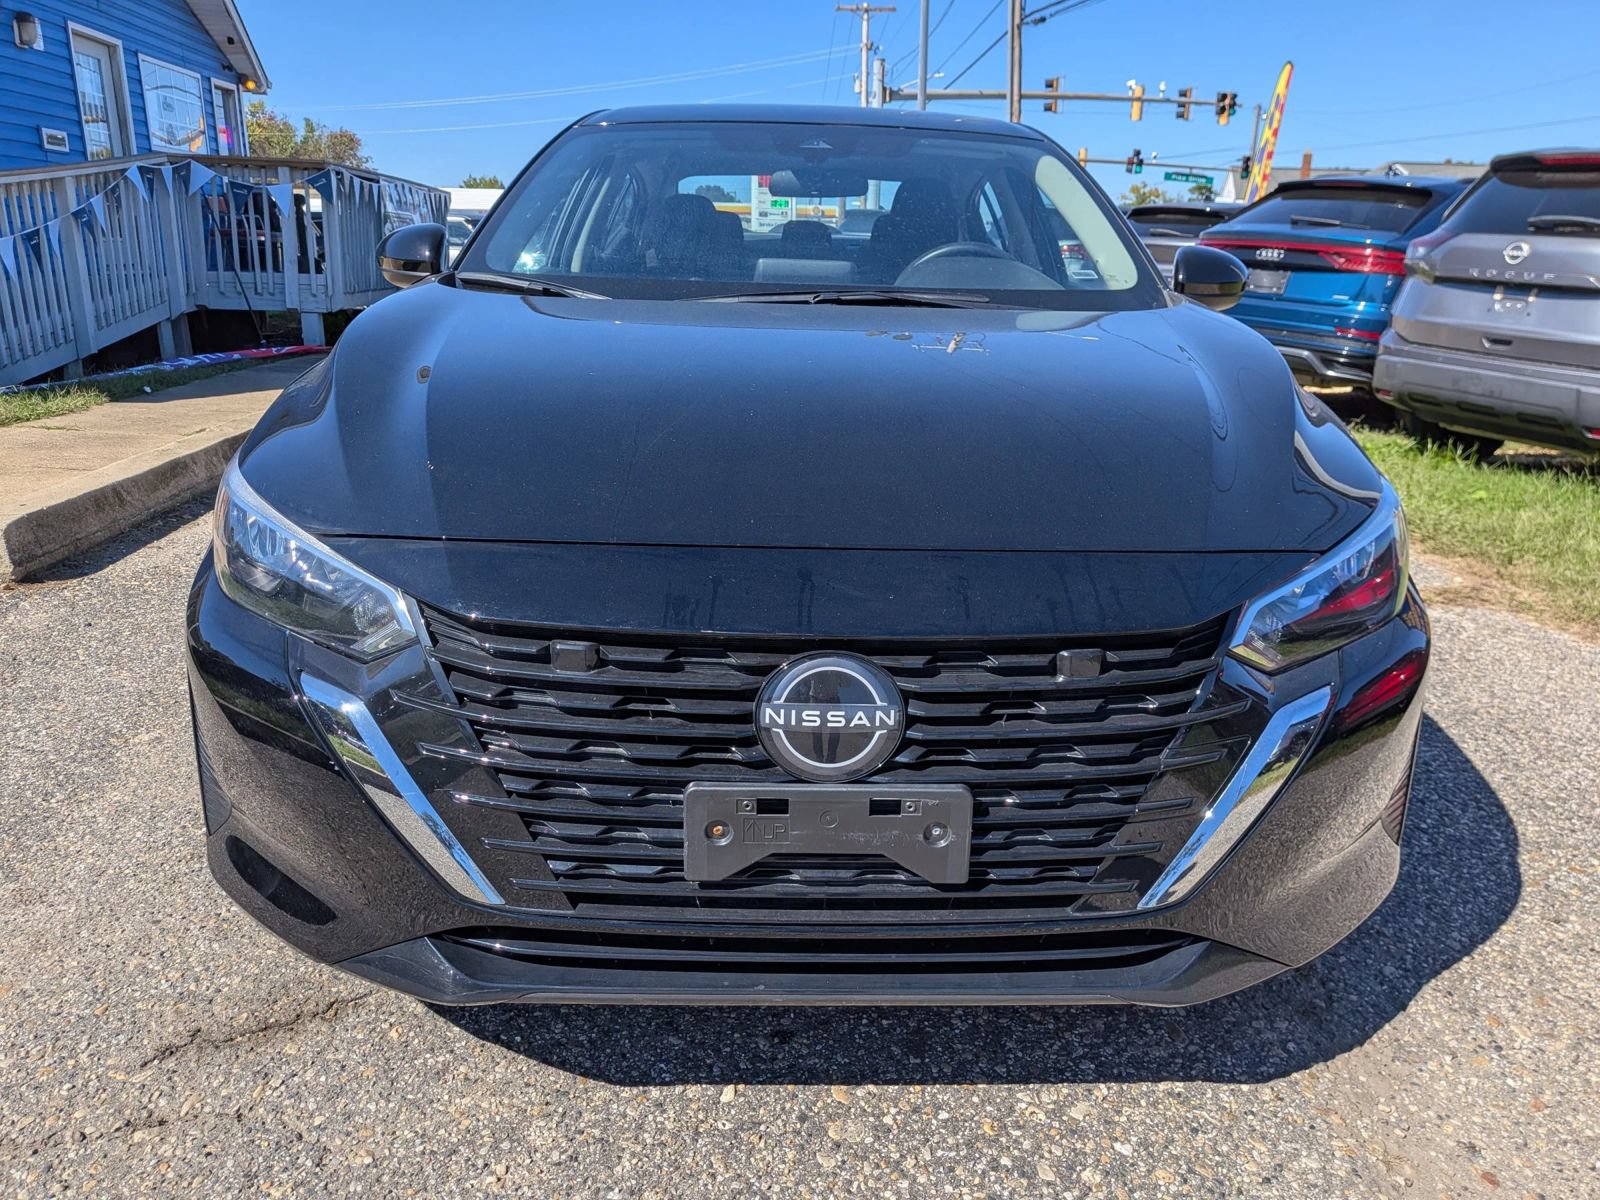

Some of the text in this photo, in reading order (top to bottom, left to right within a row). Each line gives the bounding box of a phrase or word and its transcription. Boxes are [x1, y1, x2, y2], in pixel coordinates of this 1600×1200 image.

[1469, 267, 1556, 280] ROGUE
[765, 707, 895, 727] NISSAN
[762, 823, 786, 840] UP
